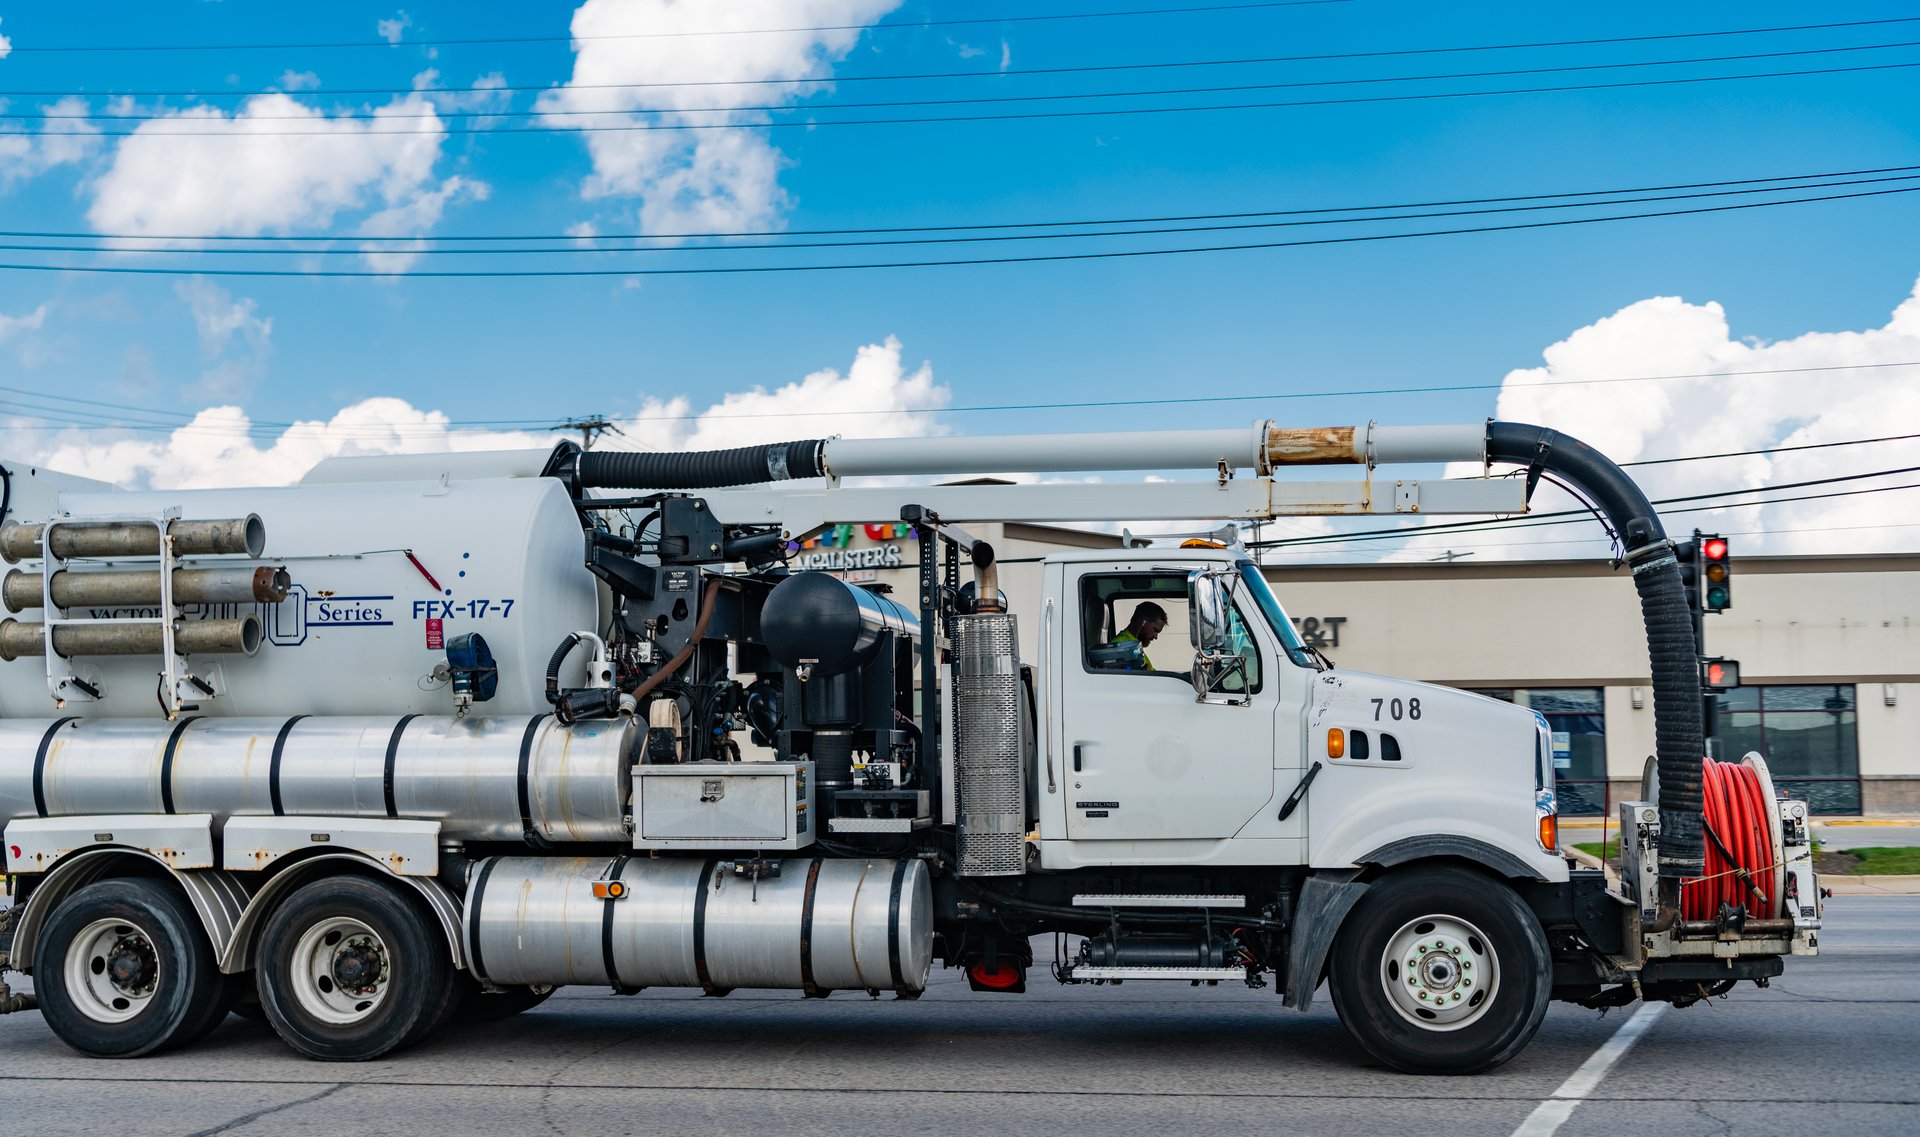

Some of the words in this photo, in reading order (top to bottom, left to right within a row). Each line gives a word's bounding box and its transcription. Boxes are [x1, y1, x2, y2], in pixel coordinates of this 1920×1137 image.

[318, 602, 383, 621] Series
[413, 600, 515, 619] FFX-17-7
[1371, 698, 1421, 721] 708
